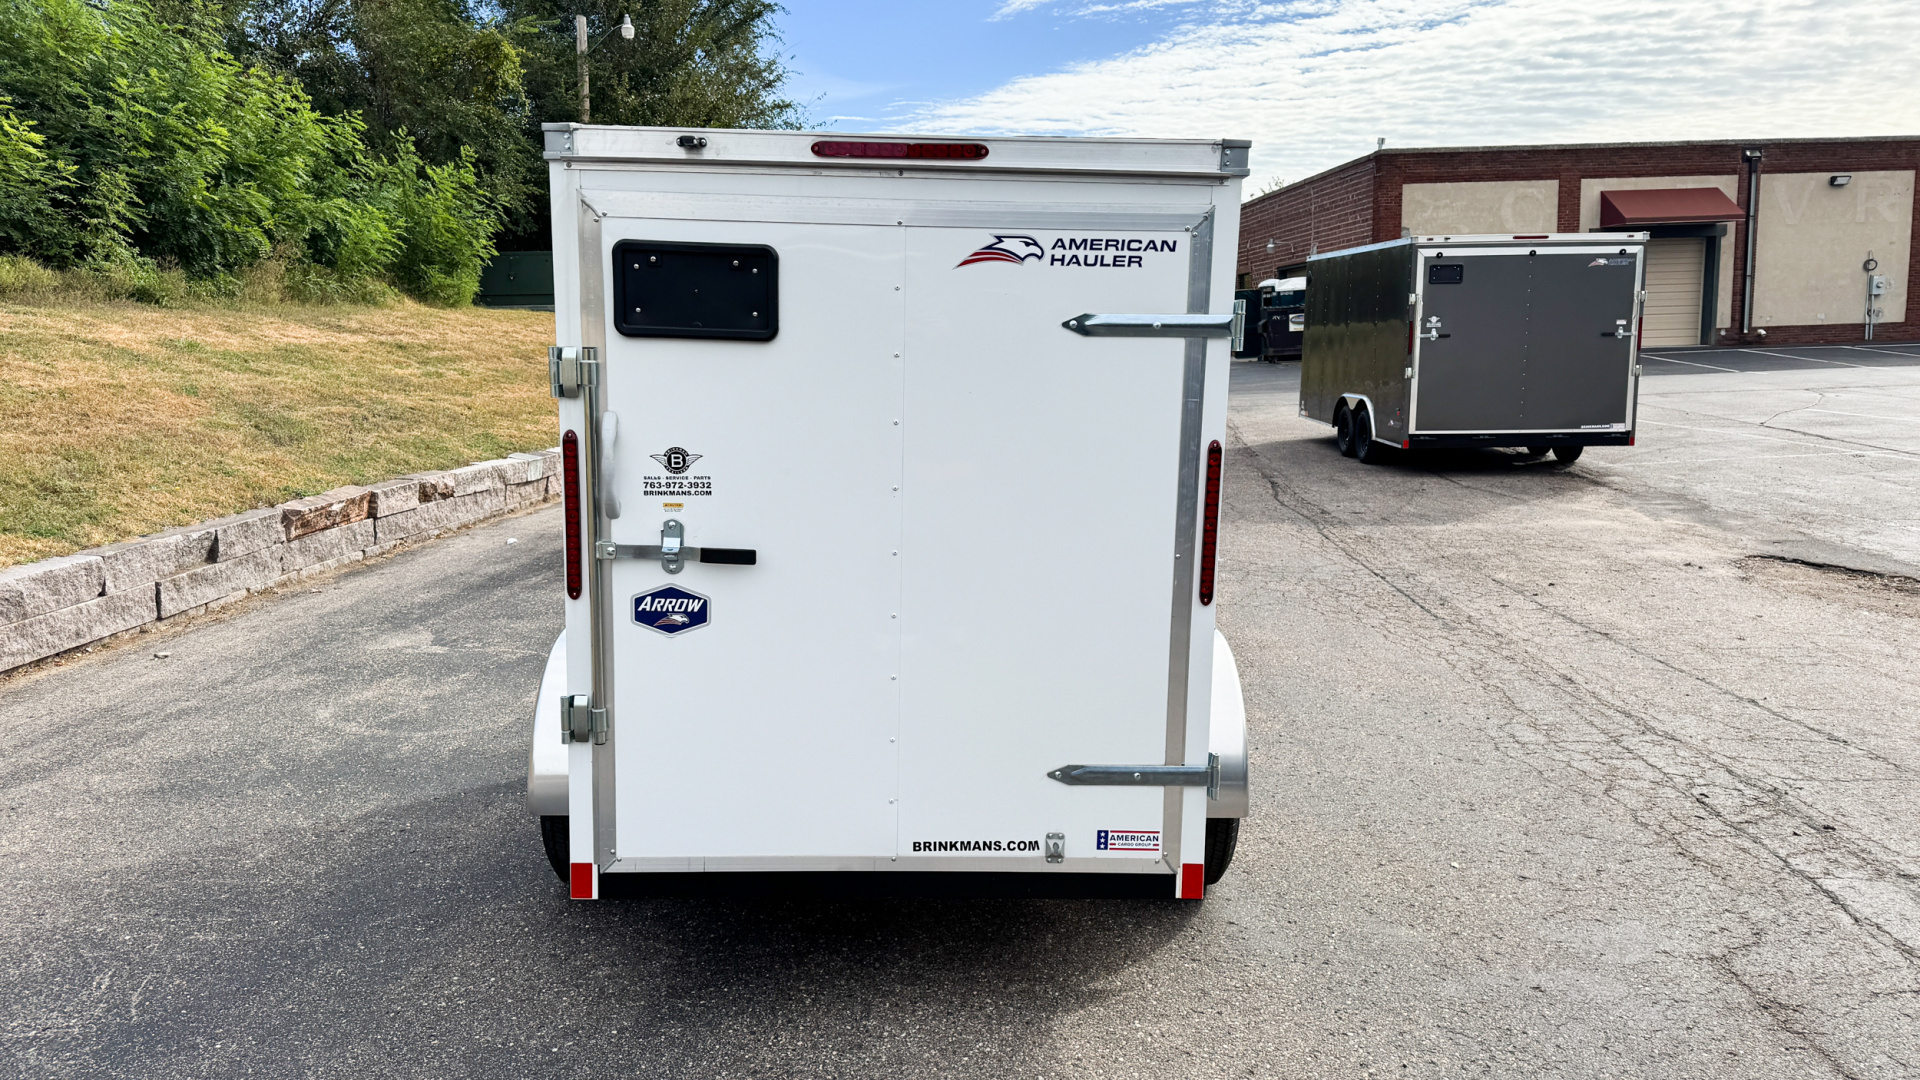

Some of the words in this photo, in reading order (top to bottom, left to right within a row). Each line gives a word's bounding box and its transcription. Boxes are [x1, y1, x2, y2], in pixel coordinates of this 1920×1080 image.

[1050, 238, 1177, 252] AMERICAN
[1050, 254, 1143, 268] HAULER
[671, 454, 684, 468] B
[637, 595, 704, 612] ARROW
[912, 840, 1040, 852] BRINKMANS.COM
